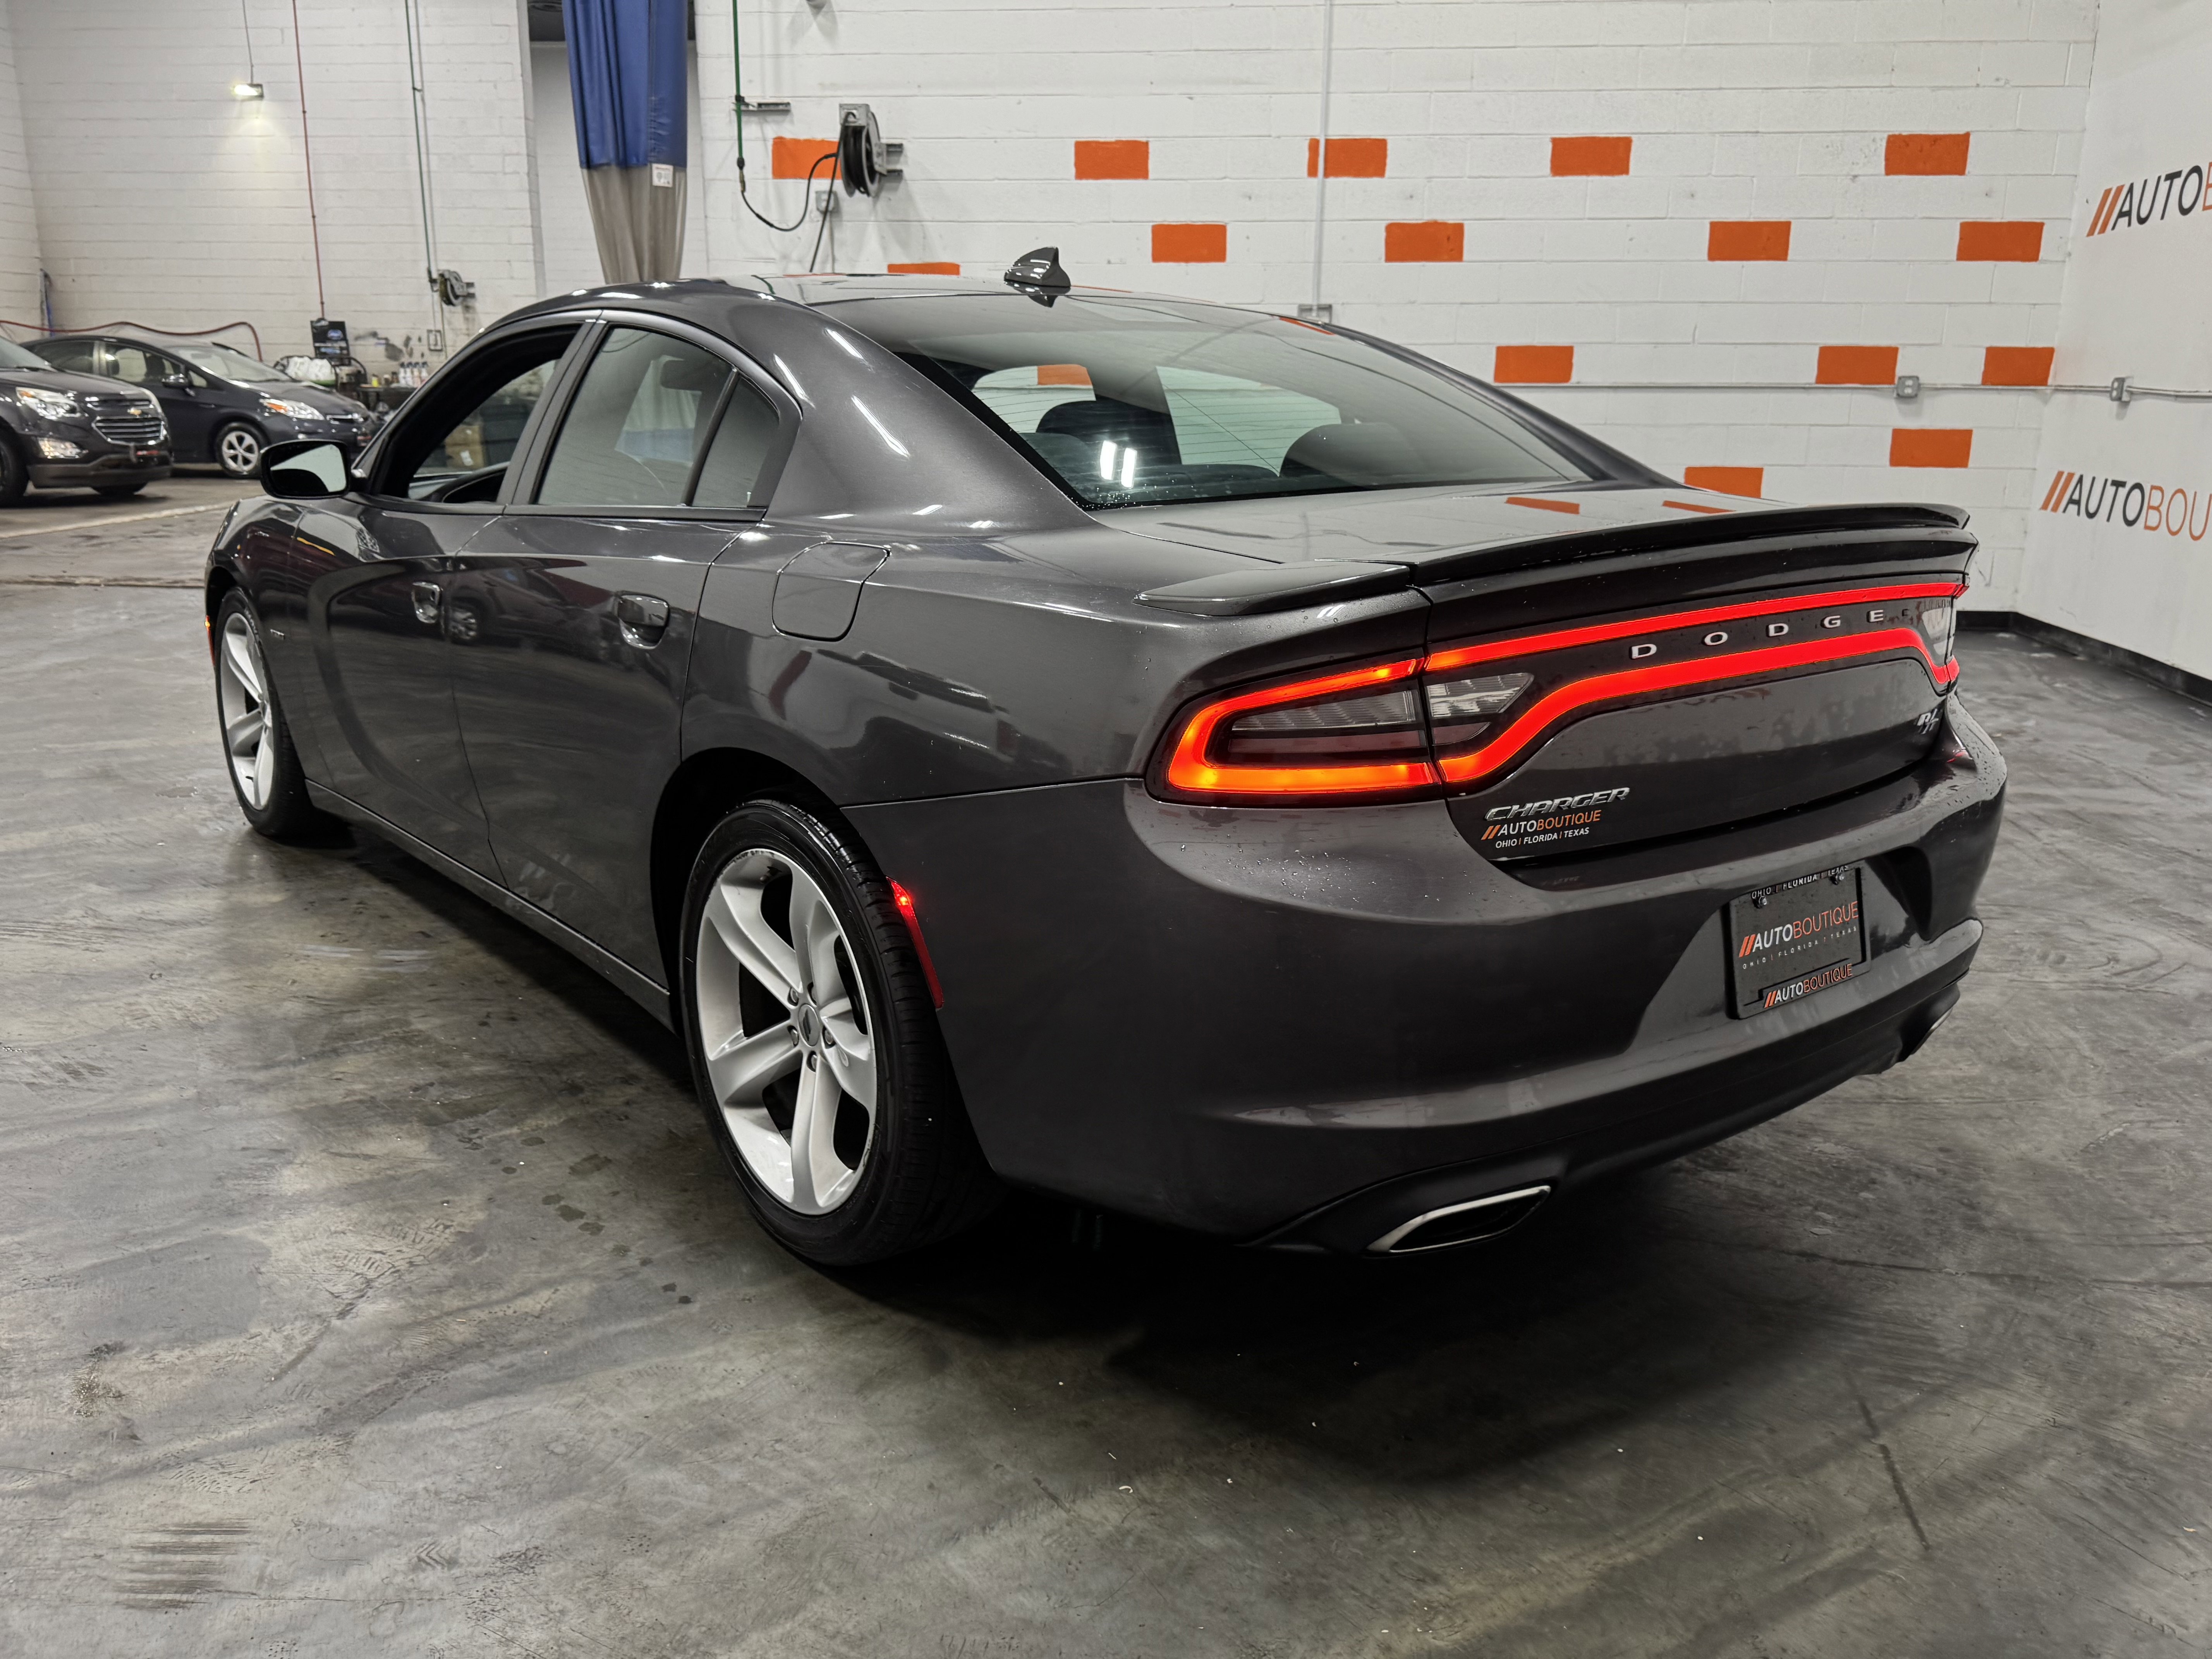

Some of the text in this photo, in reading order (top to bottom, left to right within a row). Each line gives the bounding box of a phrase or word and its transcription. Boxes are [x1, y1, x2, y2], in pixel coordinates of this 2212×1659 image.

[1631, 609, 1885, 660] DODGE
[1484, 787, 1630, 821] CHARGER
[1496, 827, 1589, 848] OHIO FLORIDA TEXAS
[1498, 810, 1601, 836] AUTOBOUTIQUE
[1752, 901, 1859, 952] AUTOBOUTIQUE
[1774, 964, 1853, 1004] AUTOBOUTIQUE
